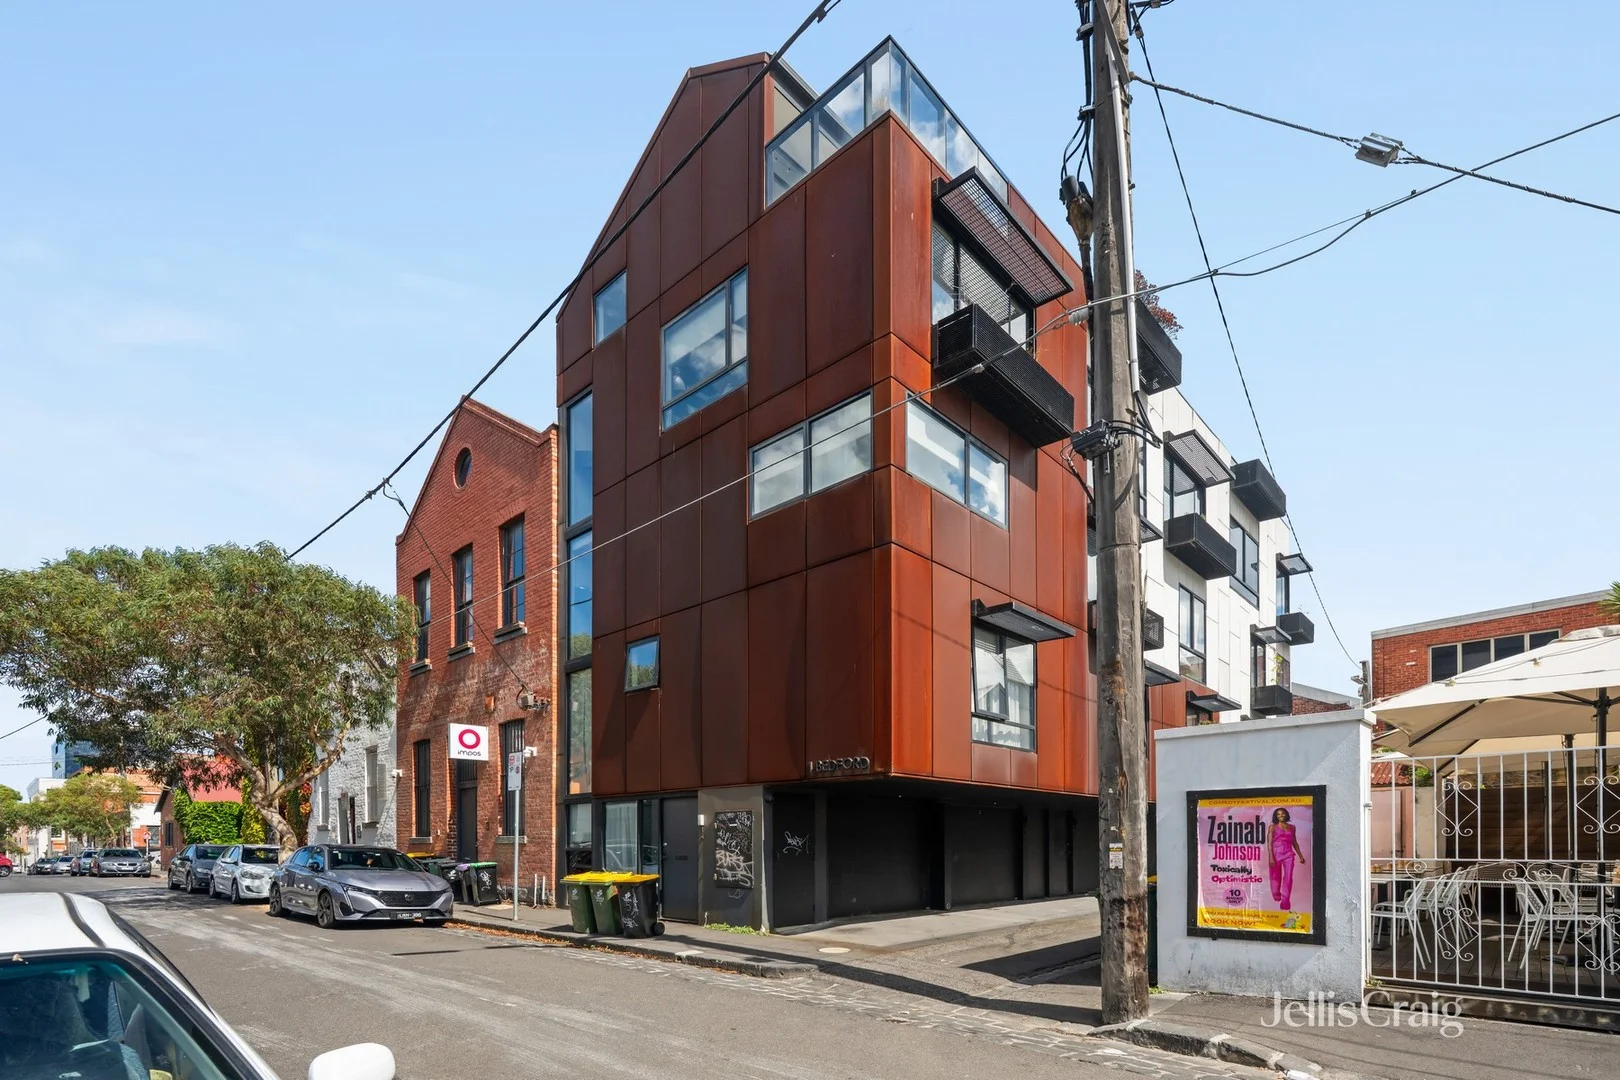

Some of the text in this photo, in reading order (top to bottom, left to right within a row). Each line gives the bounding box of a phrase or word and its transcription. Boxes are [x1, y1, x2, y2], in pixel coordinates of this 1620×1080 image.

[457, 749, 481, 757] impos
[815, 757, 870, 772] BEDFORD
[1209, 798, 1302, 806] COMEDYFESTIVAL.COM.AU
[1207, 815, 1266, 844] Zainab
[1212, 840, 1261, 861] Johnson
[1210, 864, 1252, 875] Toxically
[1211, 875, 1263, 883] Optimistic
[1229, 889, 1241, 897] 10
[1230, 919, 1256, 927] NOW!
